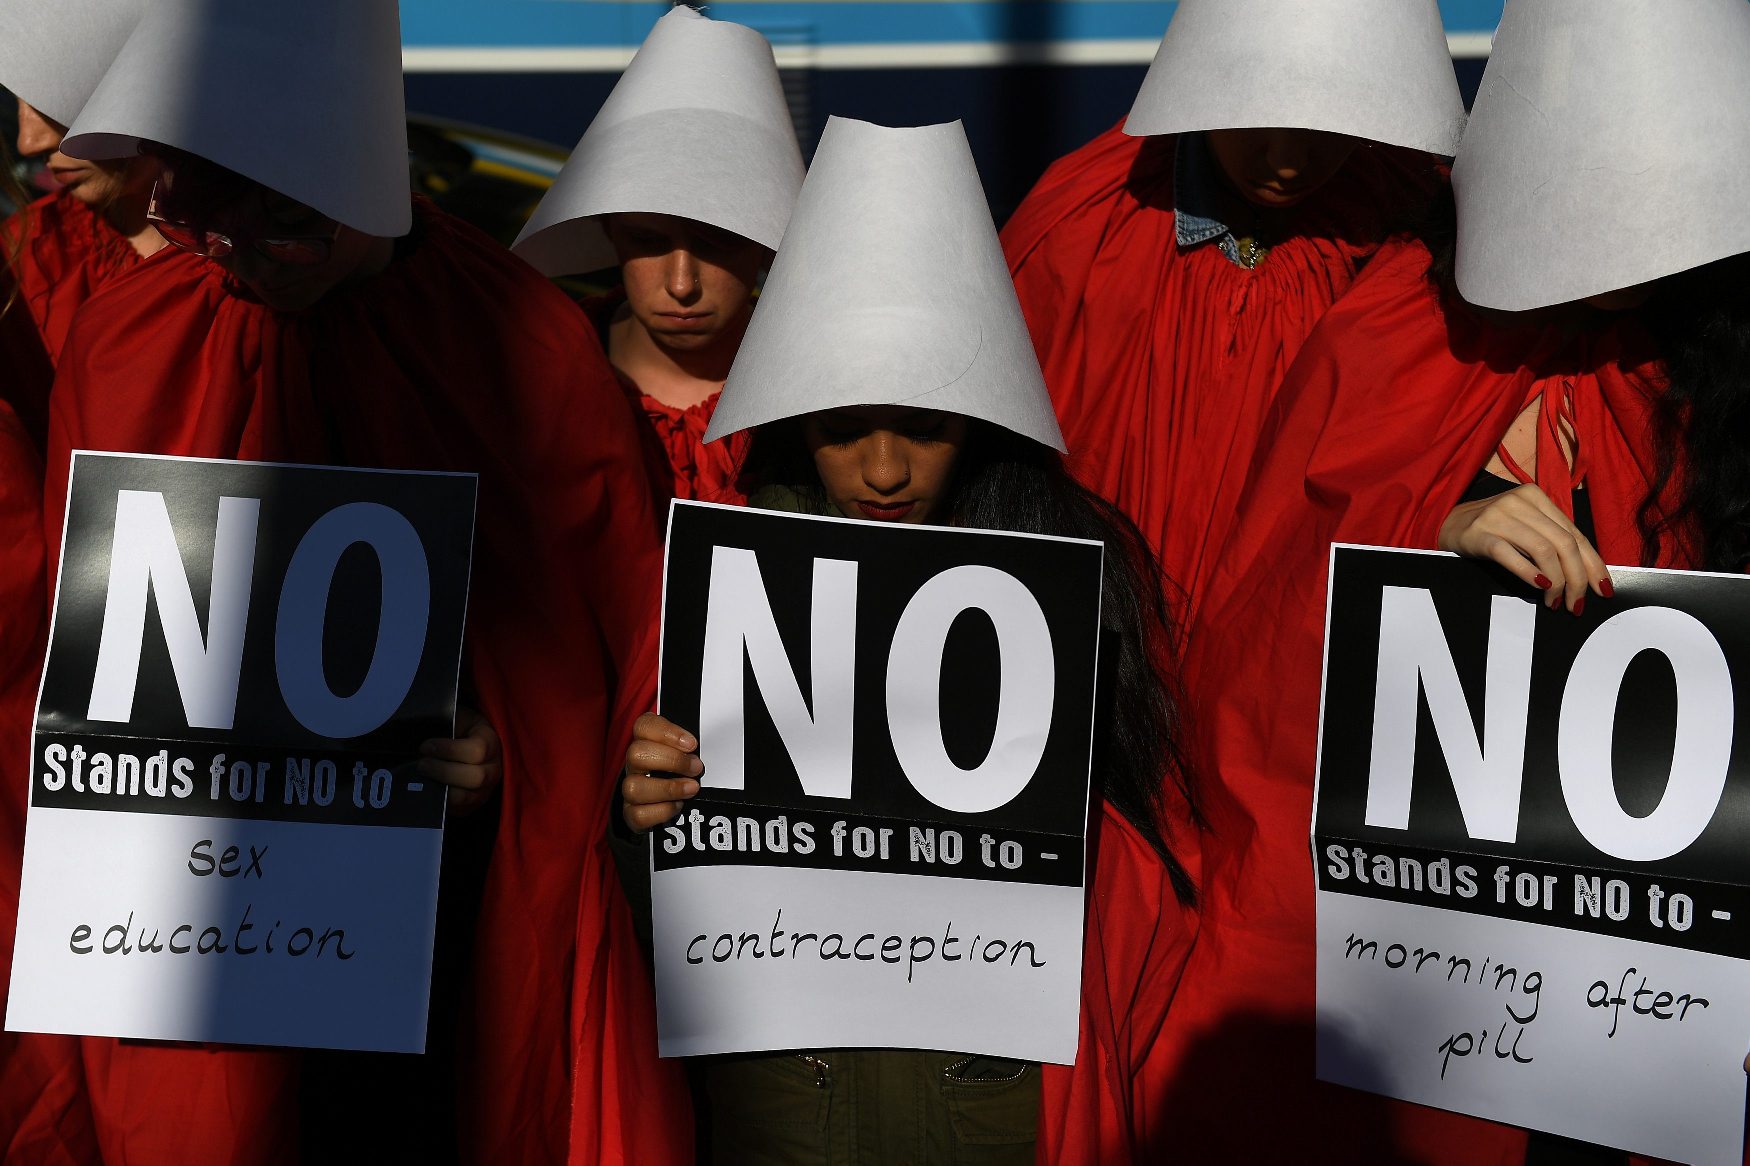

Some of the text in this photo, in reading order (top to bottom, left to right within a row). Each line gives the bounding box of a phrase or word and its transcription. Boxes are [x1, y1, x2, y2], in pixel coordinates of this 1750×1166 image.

[86, 489, 431, 739] NO
[699, 545, 1056, 814] NO
[1364, 585, 1735, 862] NO
[43, 743, 194, 799] Stands
[210, 753, 270, 803] for
[283, 757, 336, 809] NO
[352, 762, 392, 809] to
[187, 839, 270, 880] sex
[831, 821, 893, 860] for
[909, 827, 963, 866] NO
[979, 832, 1024, 870] to
[1326, 844, 1480, 898] Stands
[1495, 865, 1558, 911] for
[1574, 874, 1630, 921] NO
[1648, 884, 1693, 932] to
[69, 904, 356, 960] education
[685, 908, 1047, 984] contraception
[1344, 932, 1710, 1038] morning after
[1437, 1022, 1535, 1081] pill
